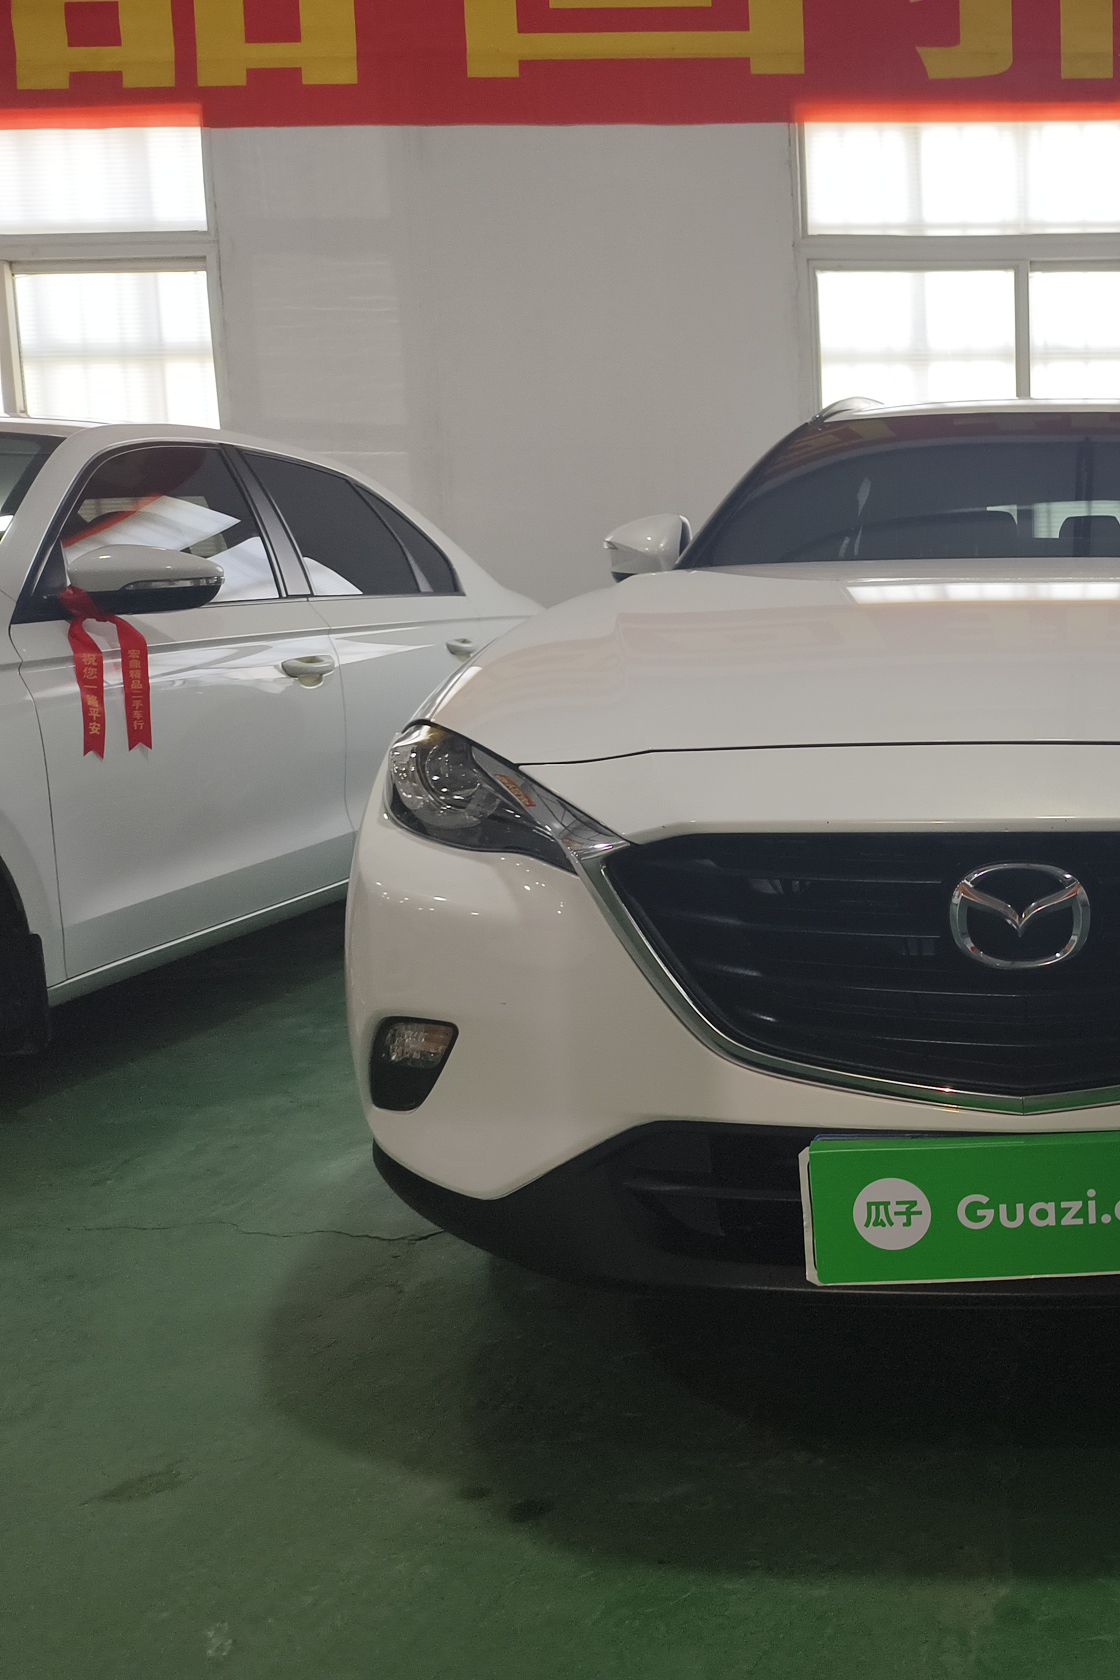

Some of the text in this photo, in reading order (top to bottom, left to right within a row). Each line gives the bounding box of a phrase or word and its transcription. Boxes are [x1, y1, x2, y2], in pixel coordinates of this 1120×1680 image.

[81, 653, 102, 735] 祝您一路平安
[864, 1200, 923, 1228] 瓜子
